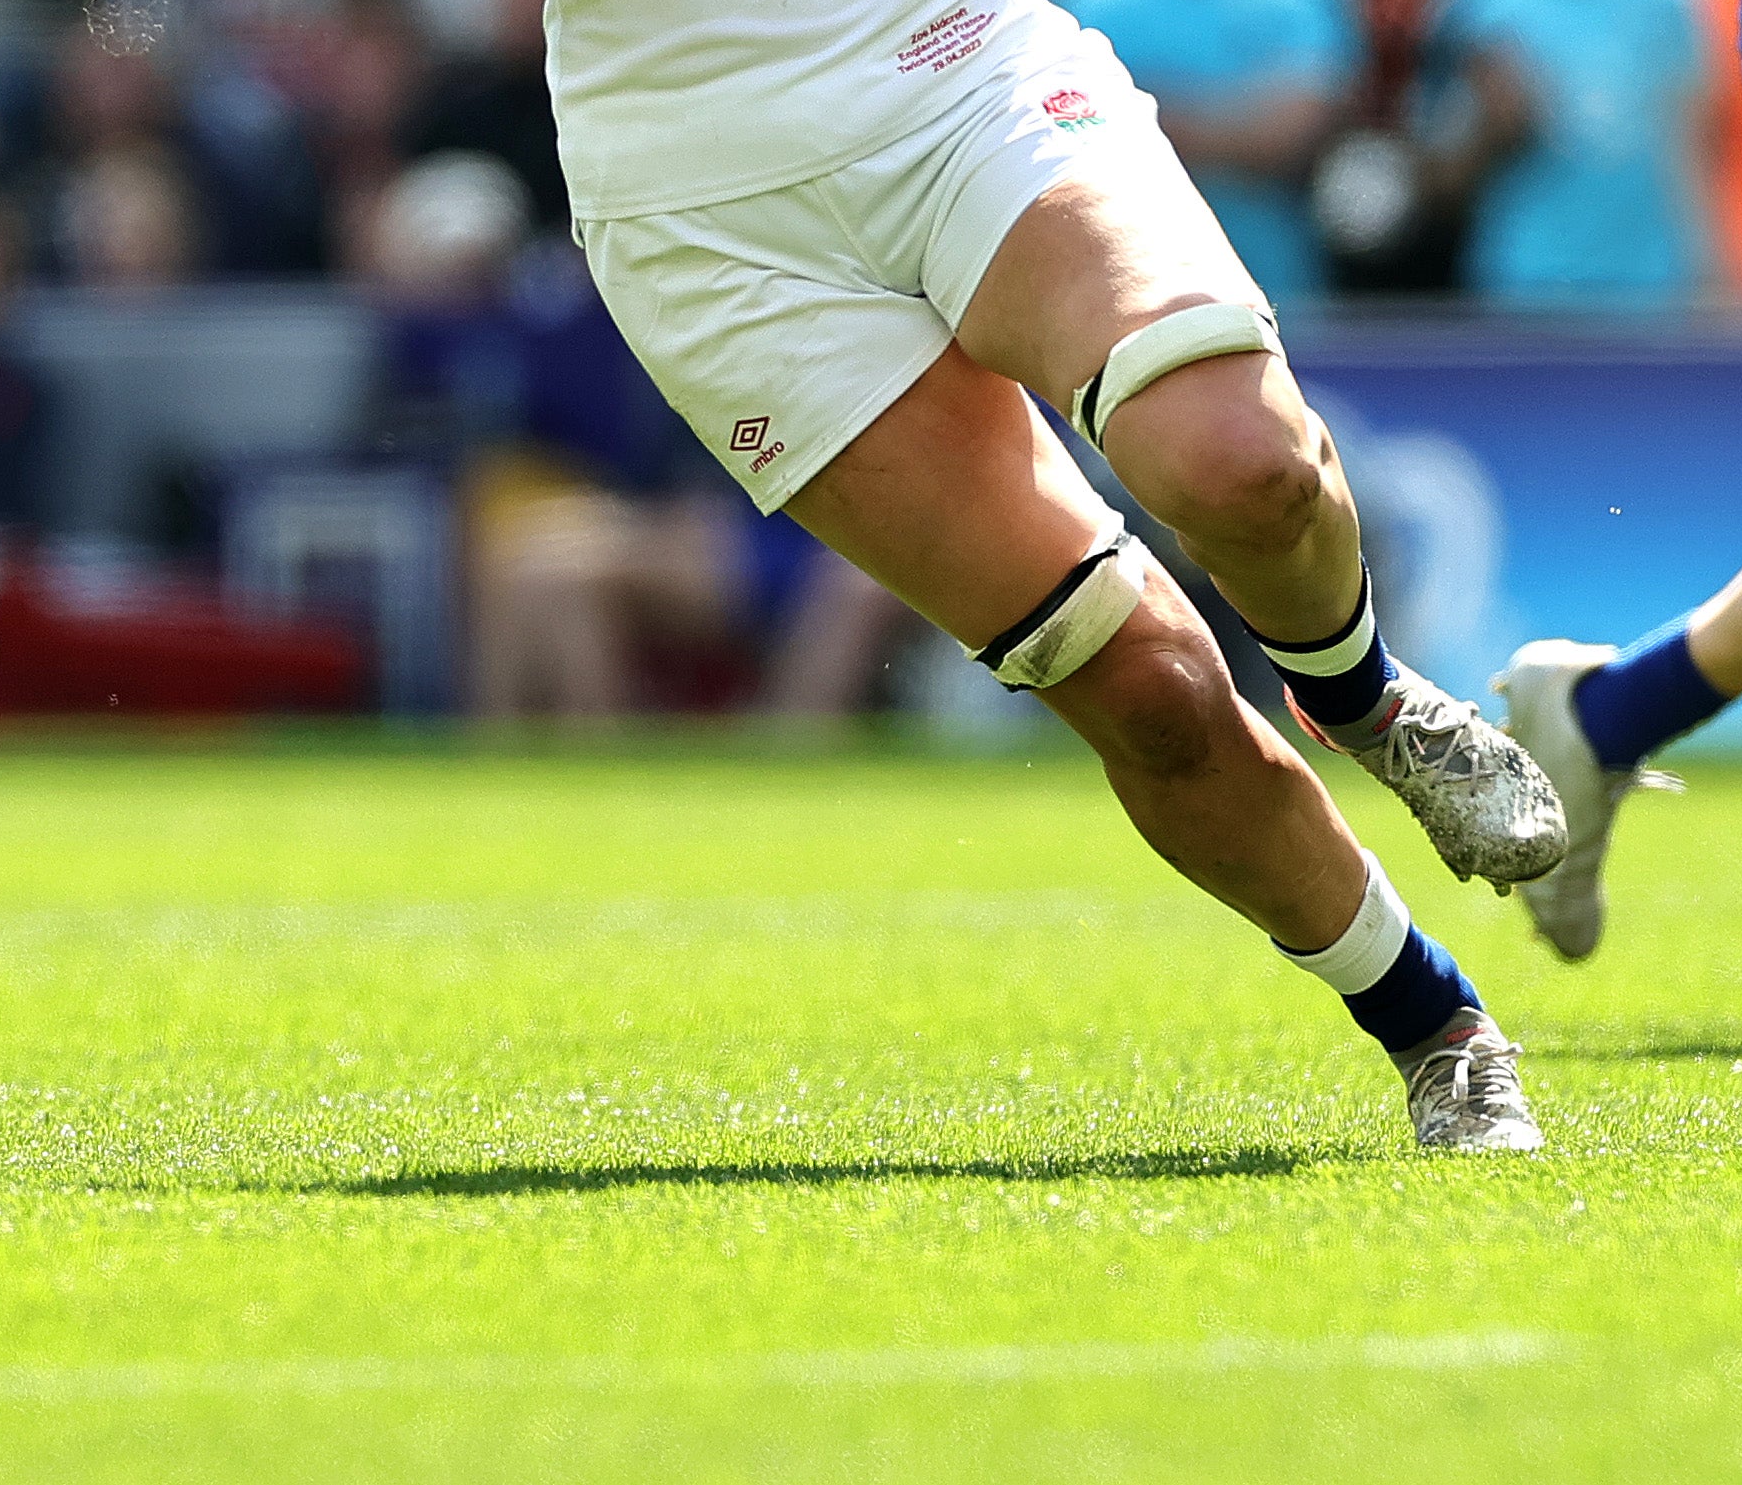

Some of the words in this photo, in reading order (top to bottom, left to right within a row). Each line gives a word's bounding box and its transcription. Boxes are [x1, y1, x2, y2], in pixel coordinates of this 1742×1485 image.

[897, 36, 941, 62] England
[941, 30, 955, 40] vs
[952, 13, 986, 33] France
[910, 29, 930, 45] Zoe
[896, 39, 961, 74] Twickenham
[749, 441, 785, 474] umbro
